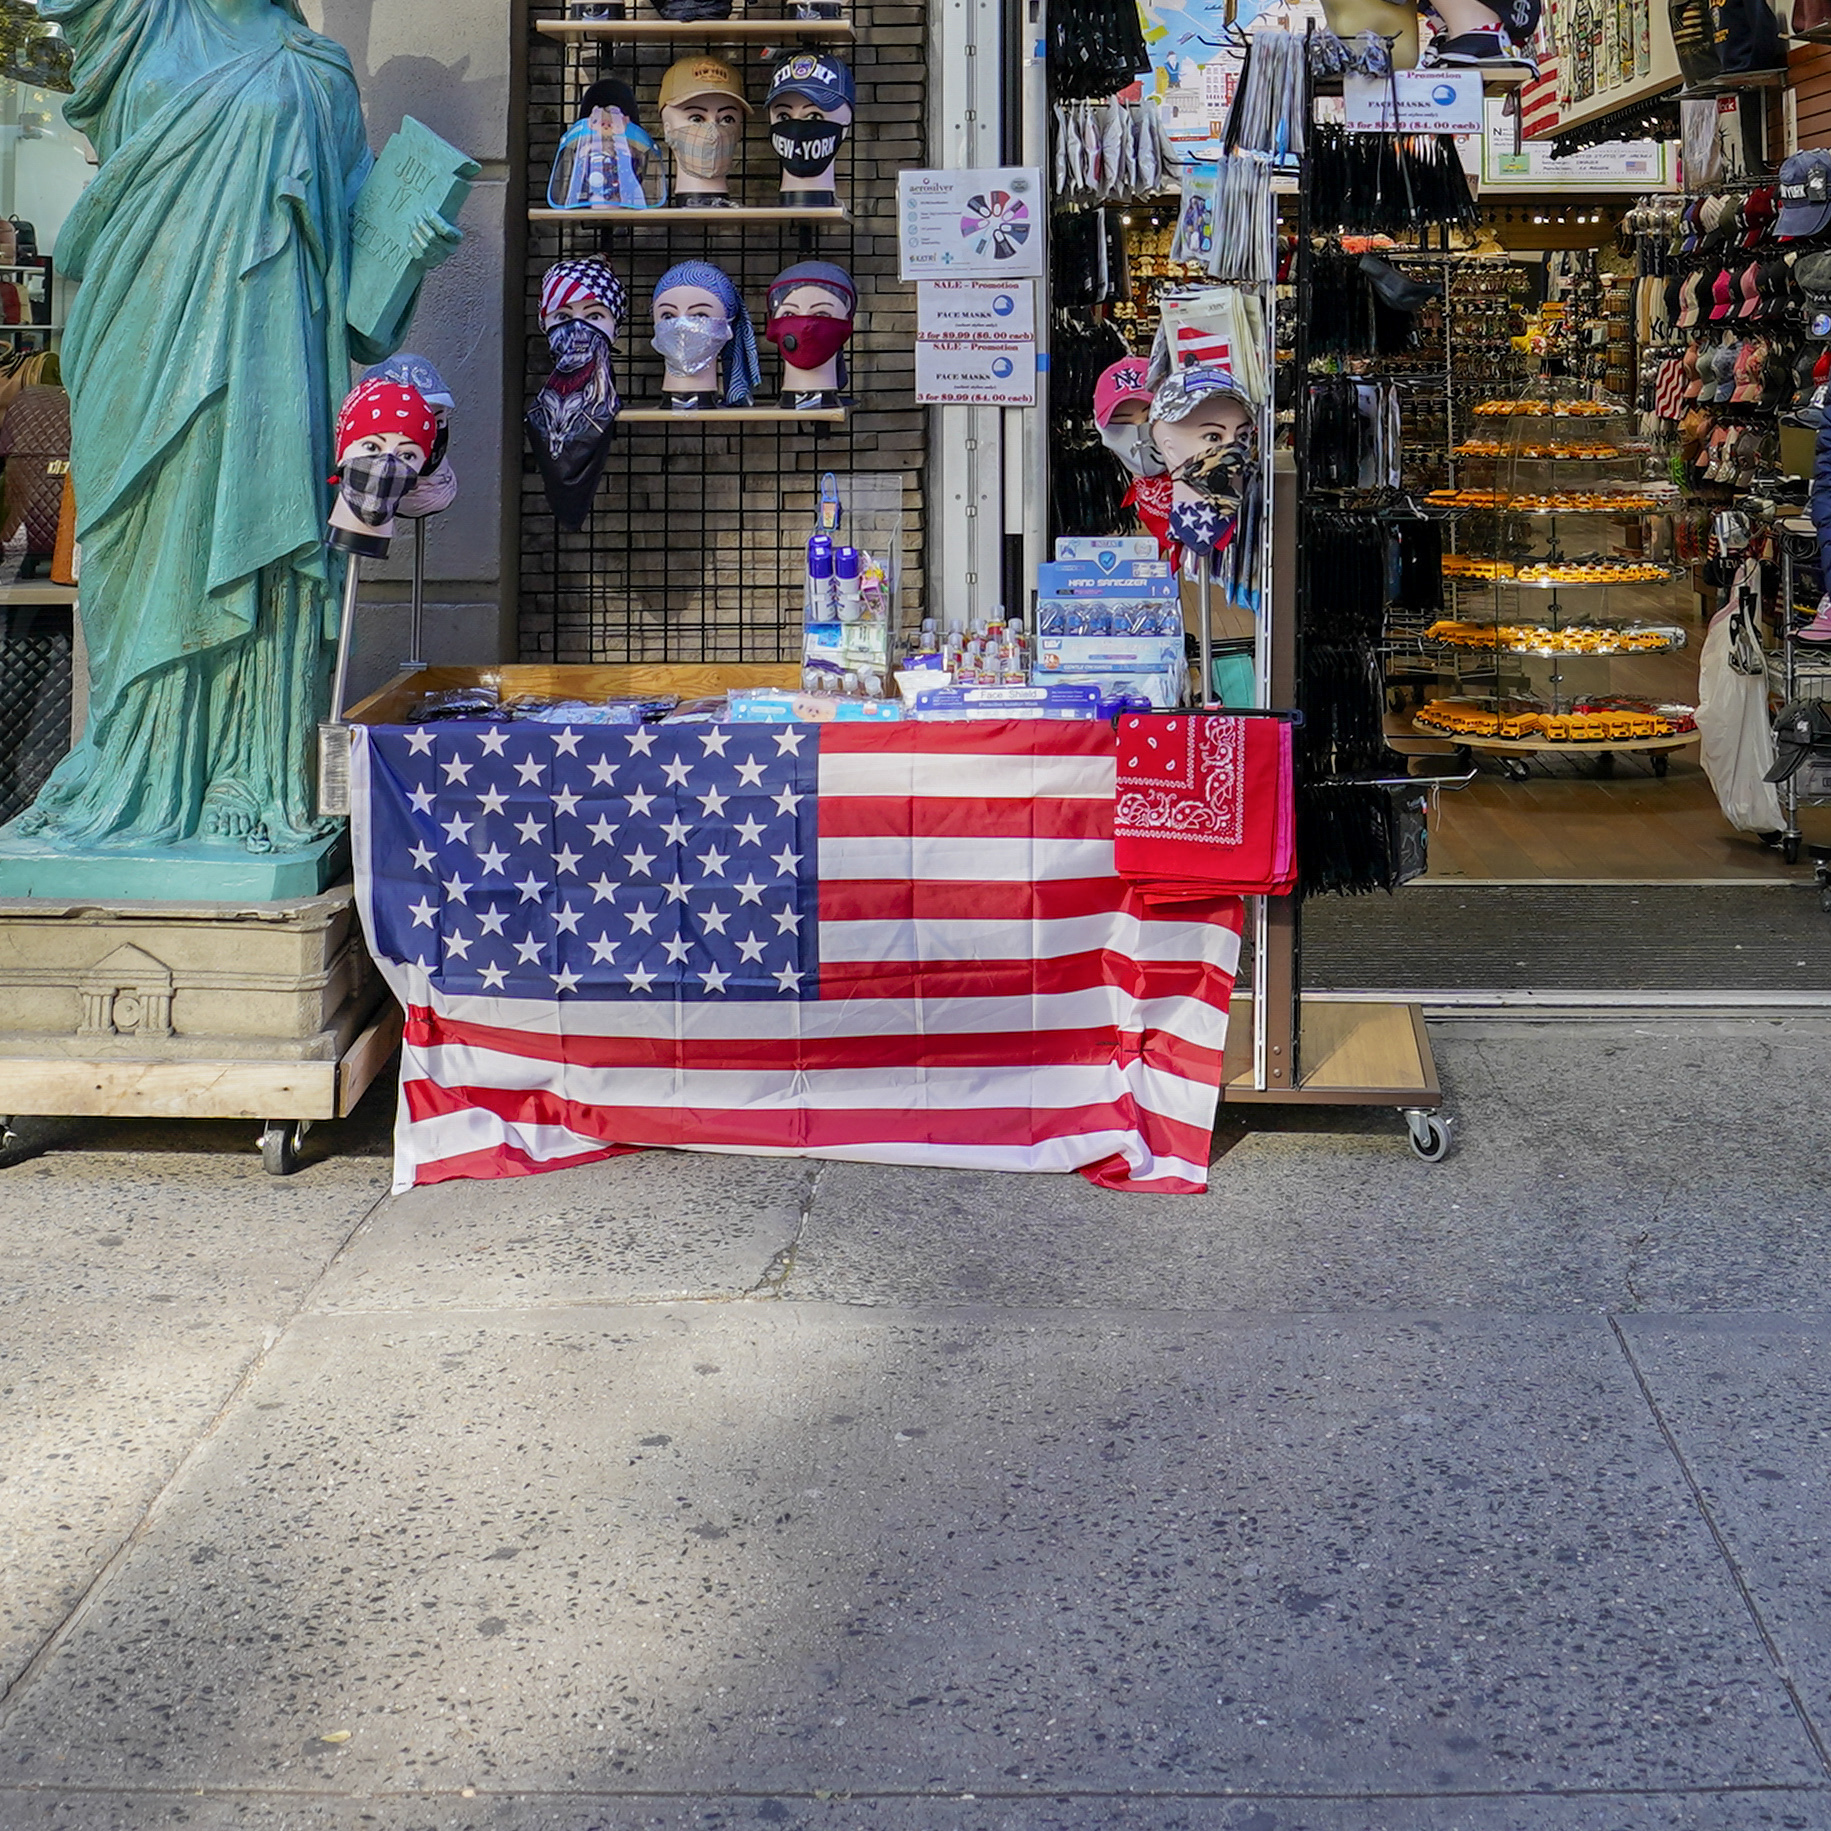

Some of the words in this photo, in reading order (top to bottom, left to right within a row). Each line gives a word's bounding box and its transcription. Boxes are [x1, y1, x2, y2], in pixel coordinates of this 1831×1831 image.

[1407, 71, 1462, 79] Promotion
[802, 136, 836, 160] YORK
[934, 281, 962, 289] SALE
[971, 281, 1019, 289] Promotion
[1009, 331, 1034, 341] each)
[933, 343, 961, 351] SALE
[970, 343, 1019, 351] Promotion
[1008, 393, 1033, 403] each)
[1069, 579, 1095, 587] HAND
[1097, 579, 1147, 587] SANITIZER
[981, 691, 1003, 700] Face
[1008, 690, 1037, 699] Shield
